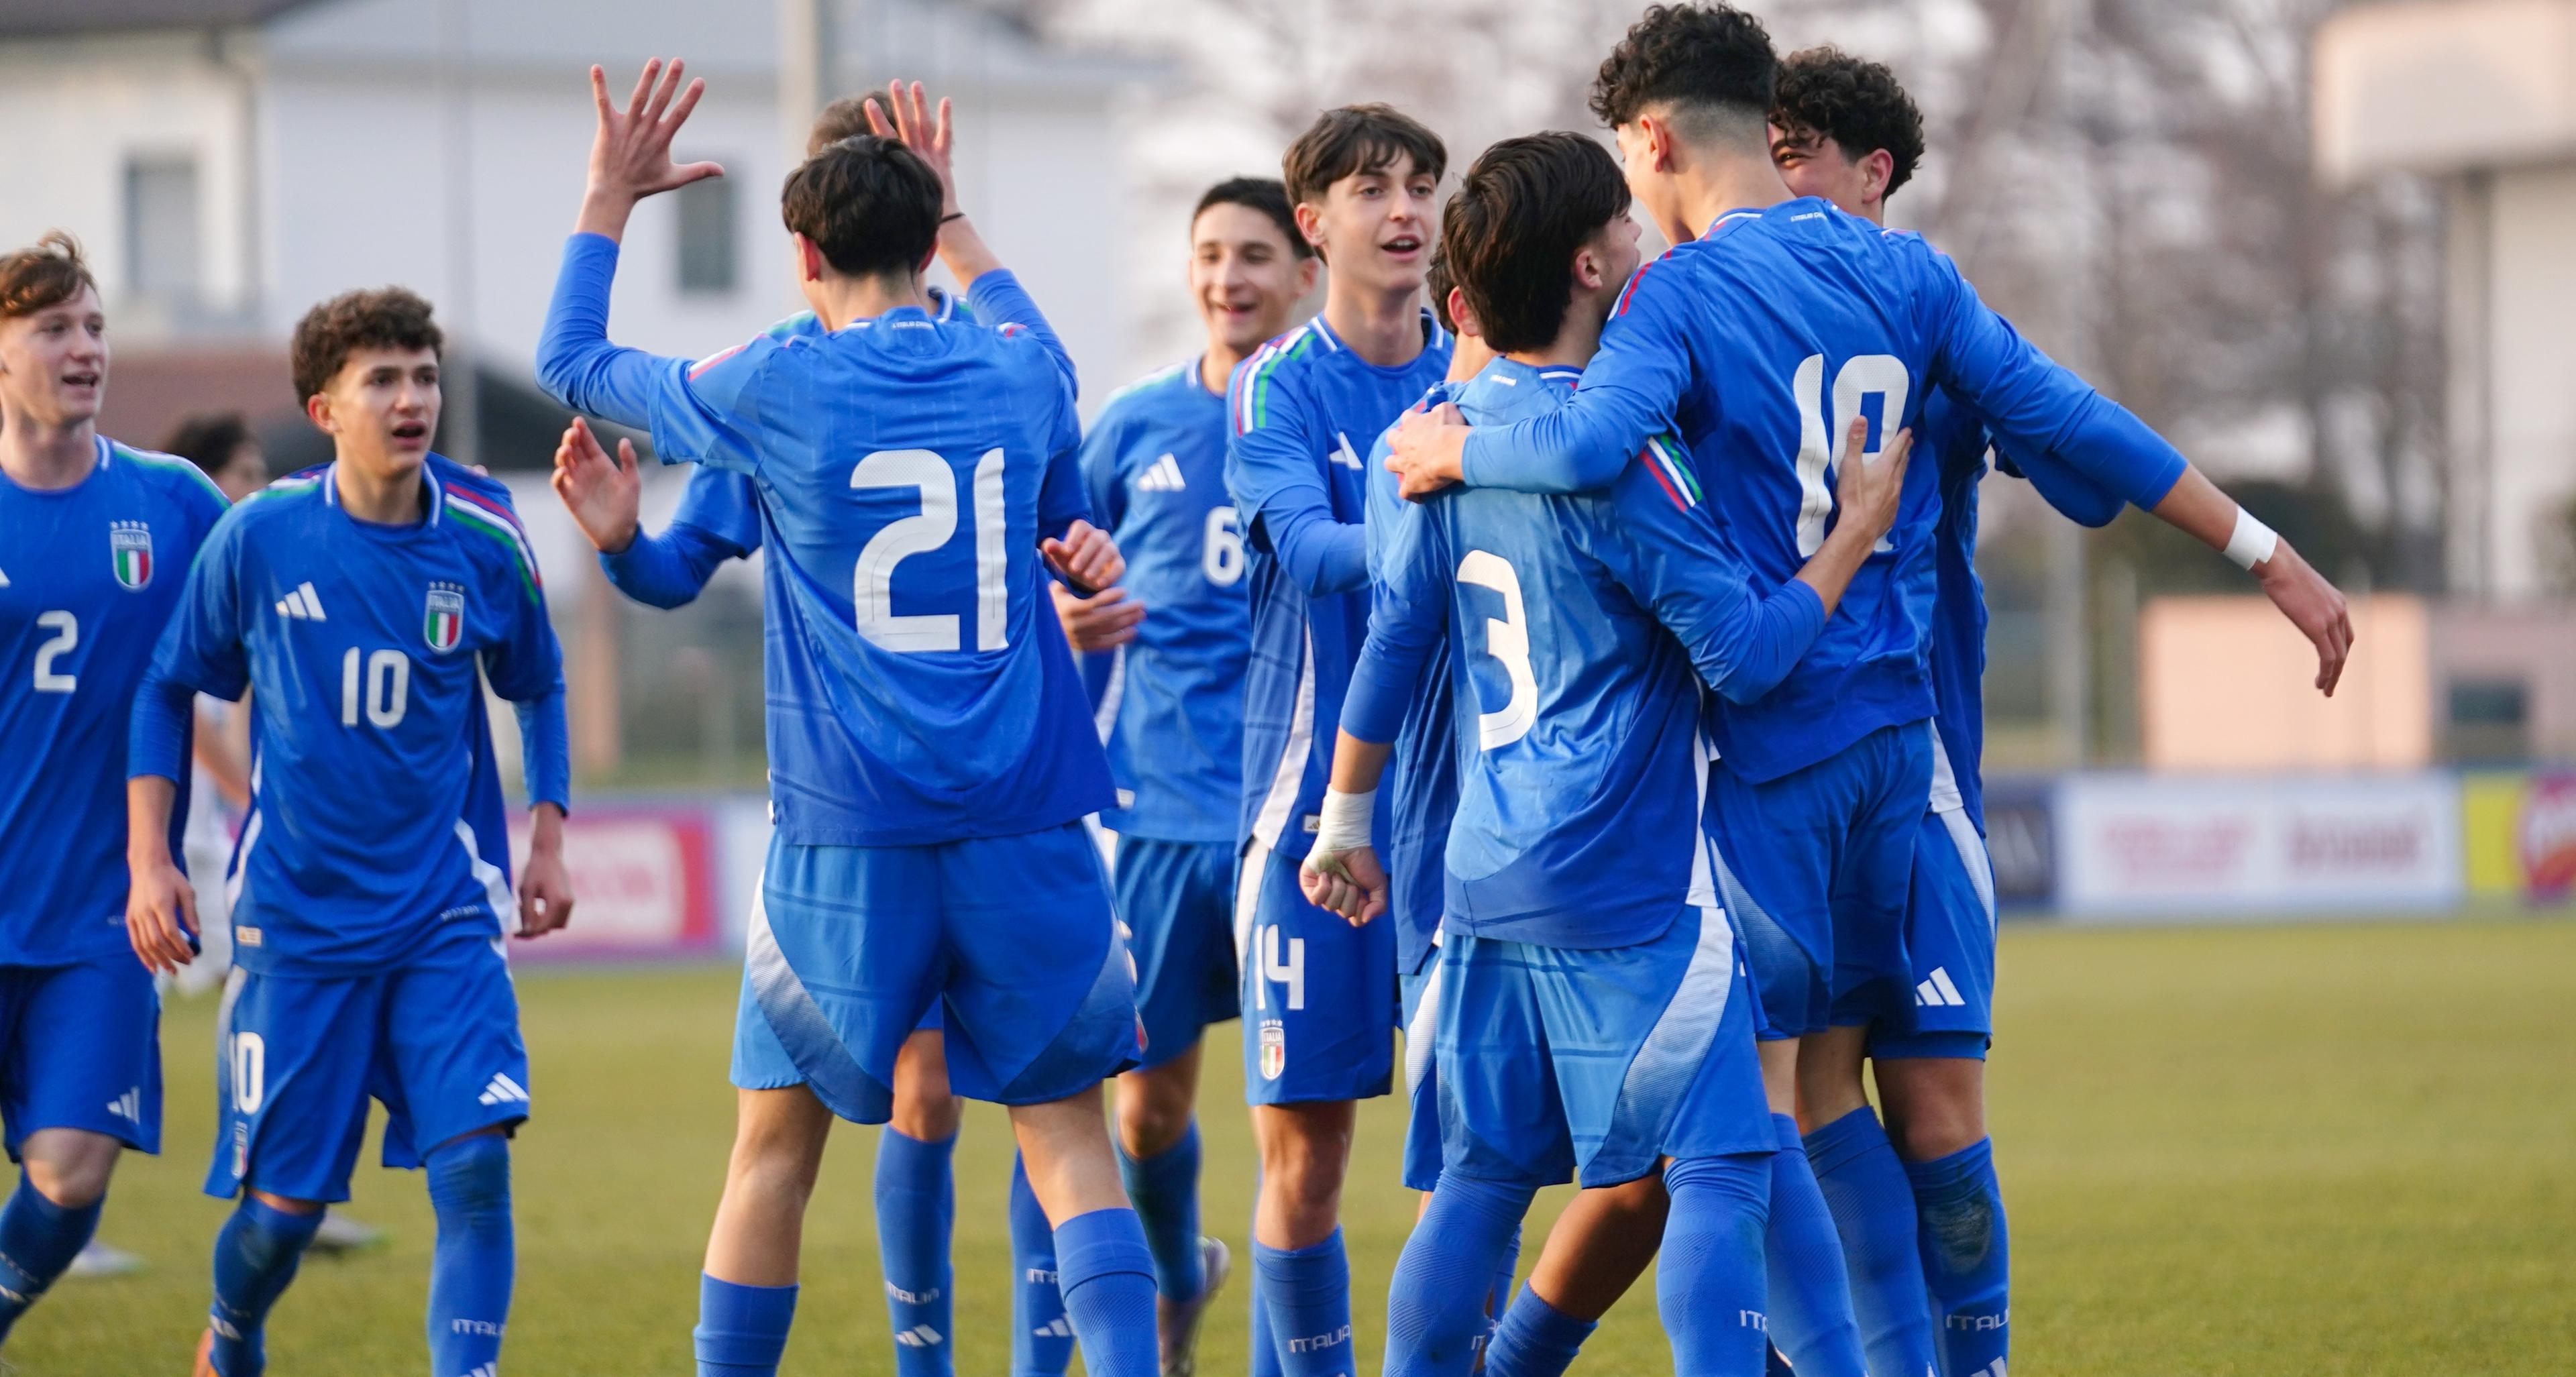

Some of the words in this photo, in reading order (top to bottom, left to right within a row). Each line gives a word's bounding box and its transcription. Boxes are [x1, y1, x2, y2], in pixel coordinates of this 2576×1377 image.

[850, 447, 1009, 653] 21
[1203, 506, 1244, 587] 6
[34, 610, 78, 693] 2
[342, 646, 410, 729] 10
[1456, 549, 1538, 752] 3
[1254, 924, 1305, 1011] 14
[1289, 1324, 1350, 1354] ITALIA
